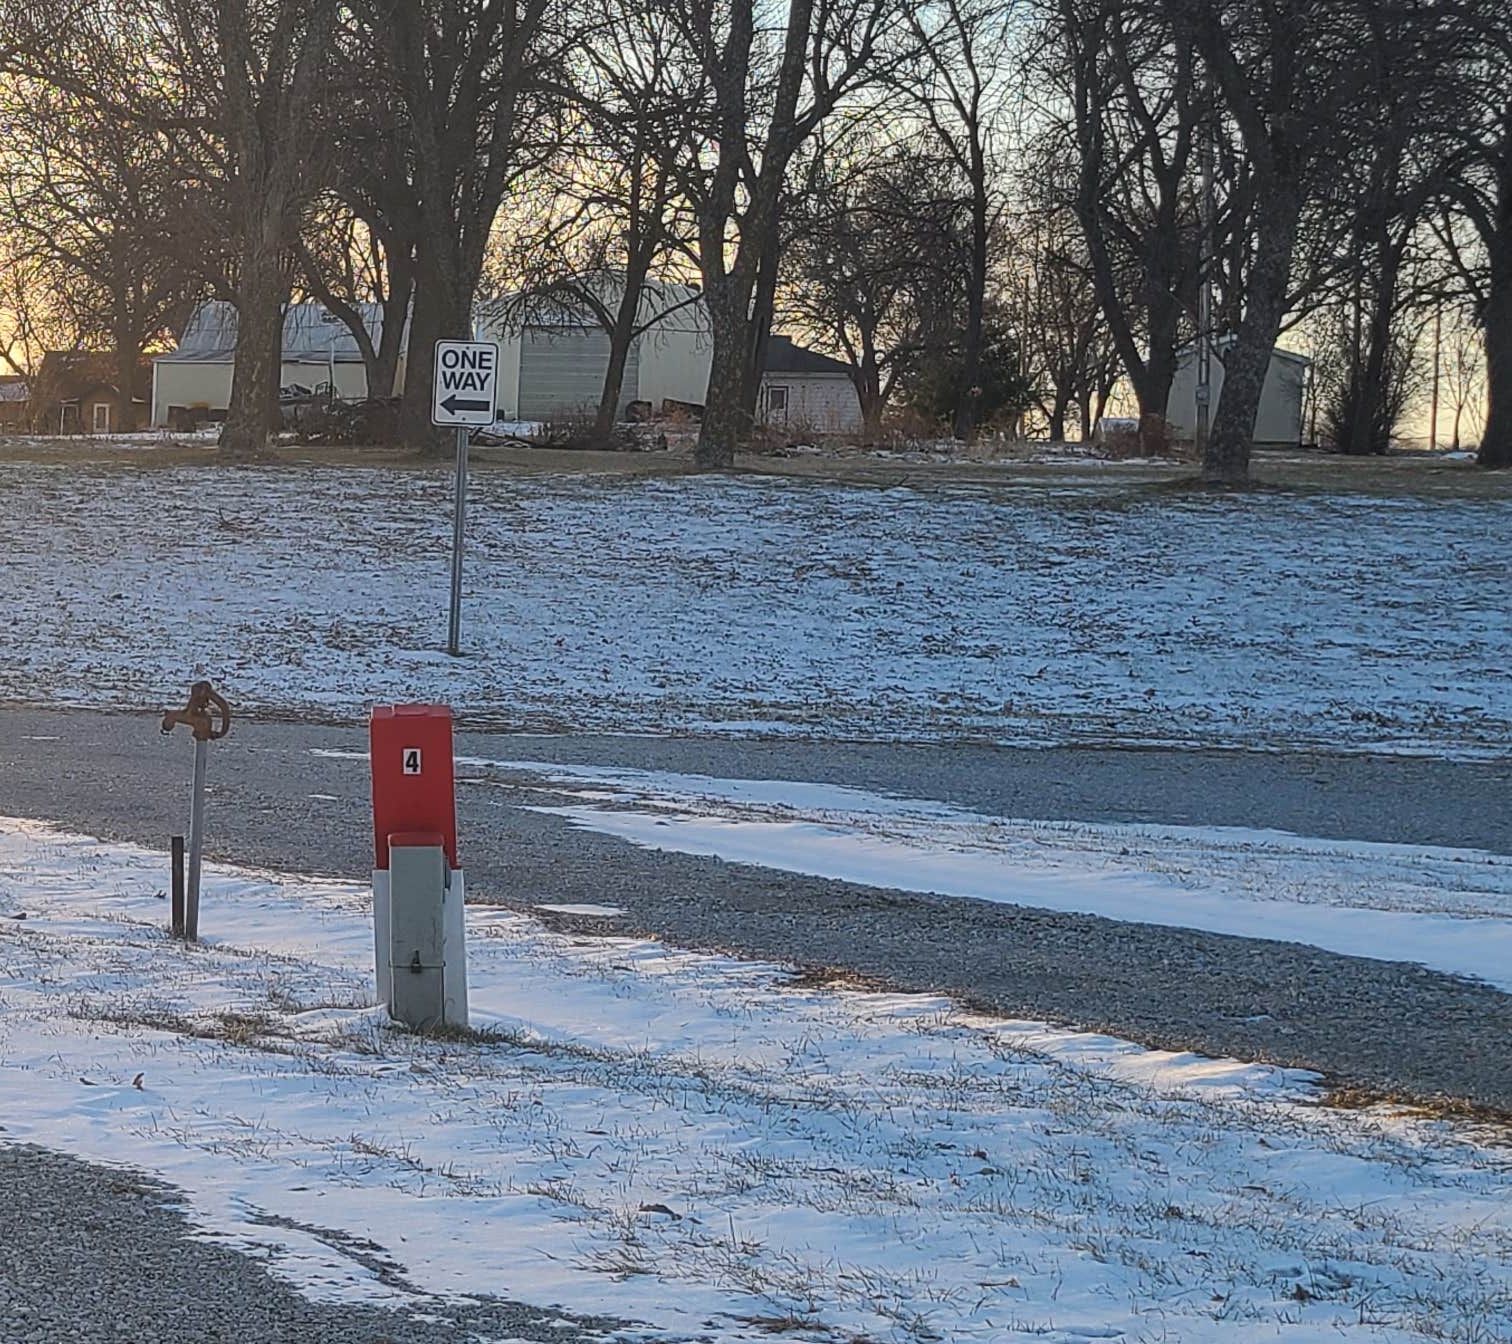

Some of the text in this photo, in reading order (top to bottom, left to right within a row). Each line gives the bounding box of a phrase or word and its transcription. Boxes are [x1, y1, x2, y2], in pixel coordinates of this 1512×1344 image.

[441, 349, 493, 370] ONE
[441, 370, 491, 391] WAY
[405, 750, 419, 772] 4
